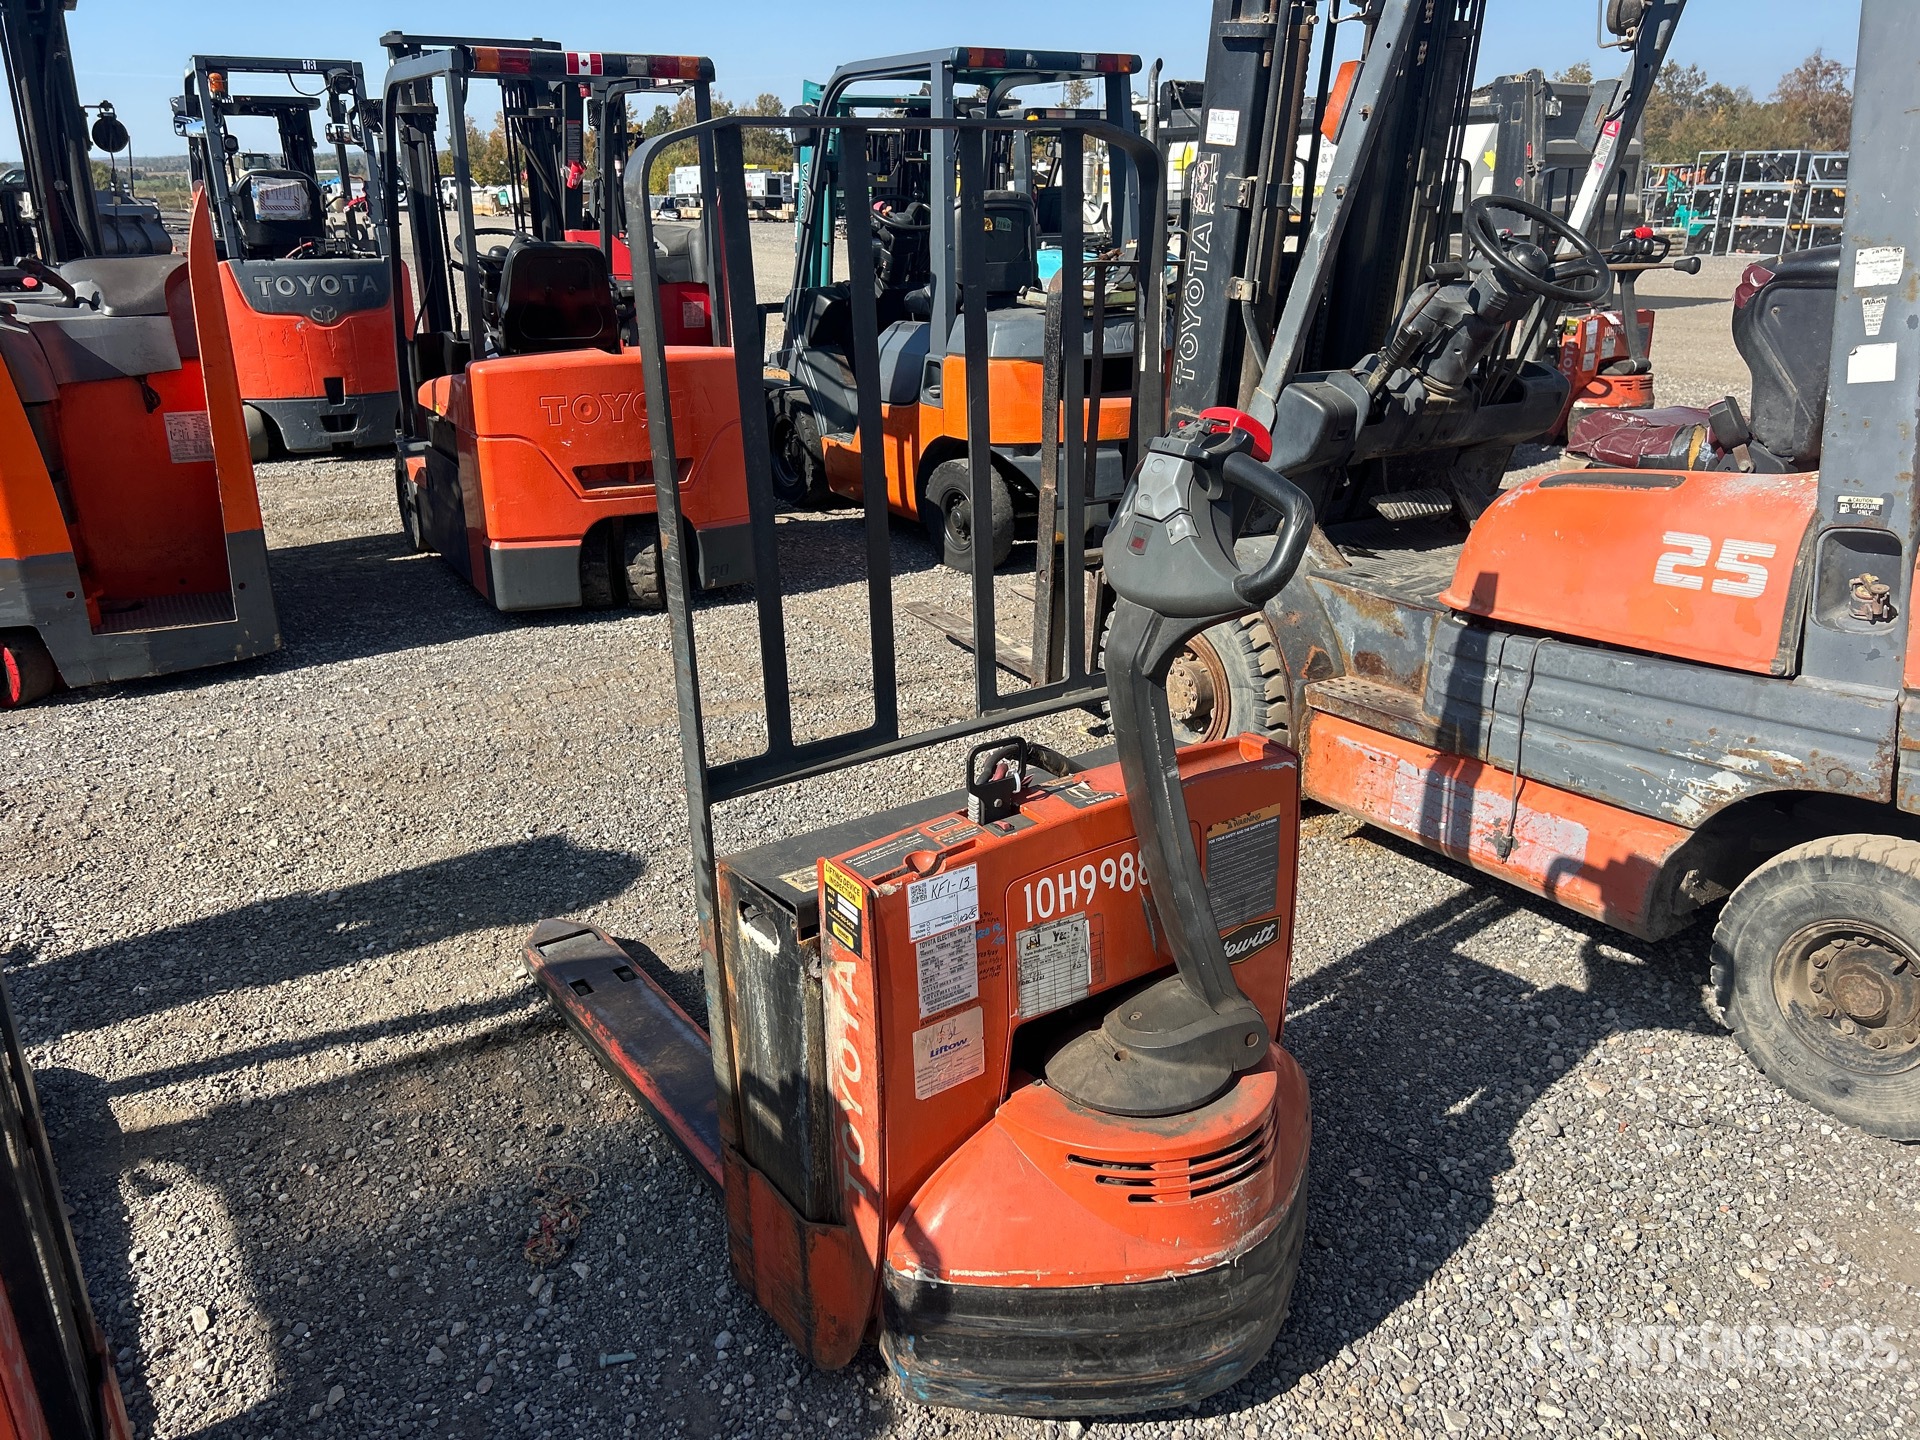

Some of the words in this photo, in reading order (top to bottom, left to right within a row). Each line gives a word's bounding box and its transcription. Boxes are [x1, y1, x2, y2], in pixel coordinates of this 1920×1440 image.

[253, 274, 379, 297] TOYOTA
[1174, 221, 1213, 384] TOYOTA
[1851, 503, 1880, 511] GASOLINE
[1652, 530, 1777, 599] 25
[1233, 812, 1262, 827] WARNING
[825, 863, 843, 881] LIFTING
[842, 875, 860, 897] DEVICE
[828, 875, 857, 903] INSPECTION
[919, 937, 937, 950] TOYOTA
[936, 930, 957, 943] ELECTRIC
[957, 924, 972, 935] TRUCK
[929, 1037, 968, 1059] Liftow
[833, 961, 867, 1200] TOYOTA
